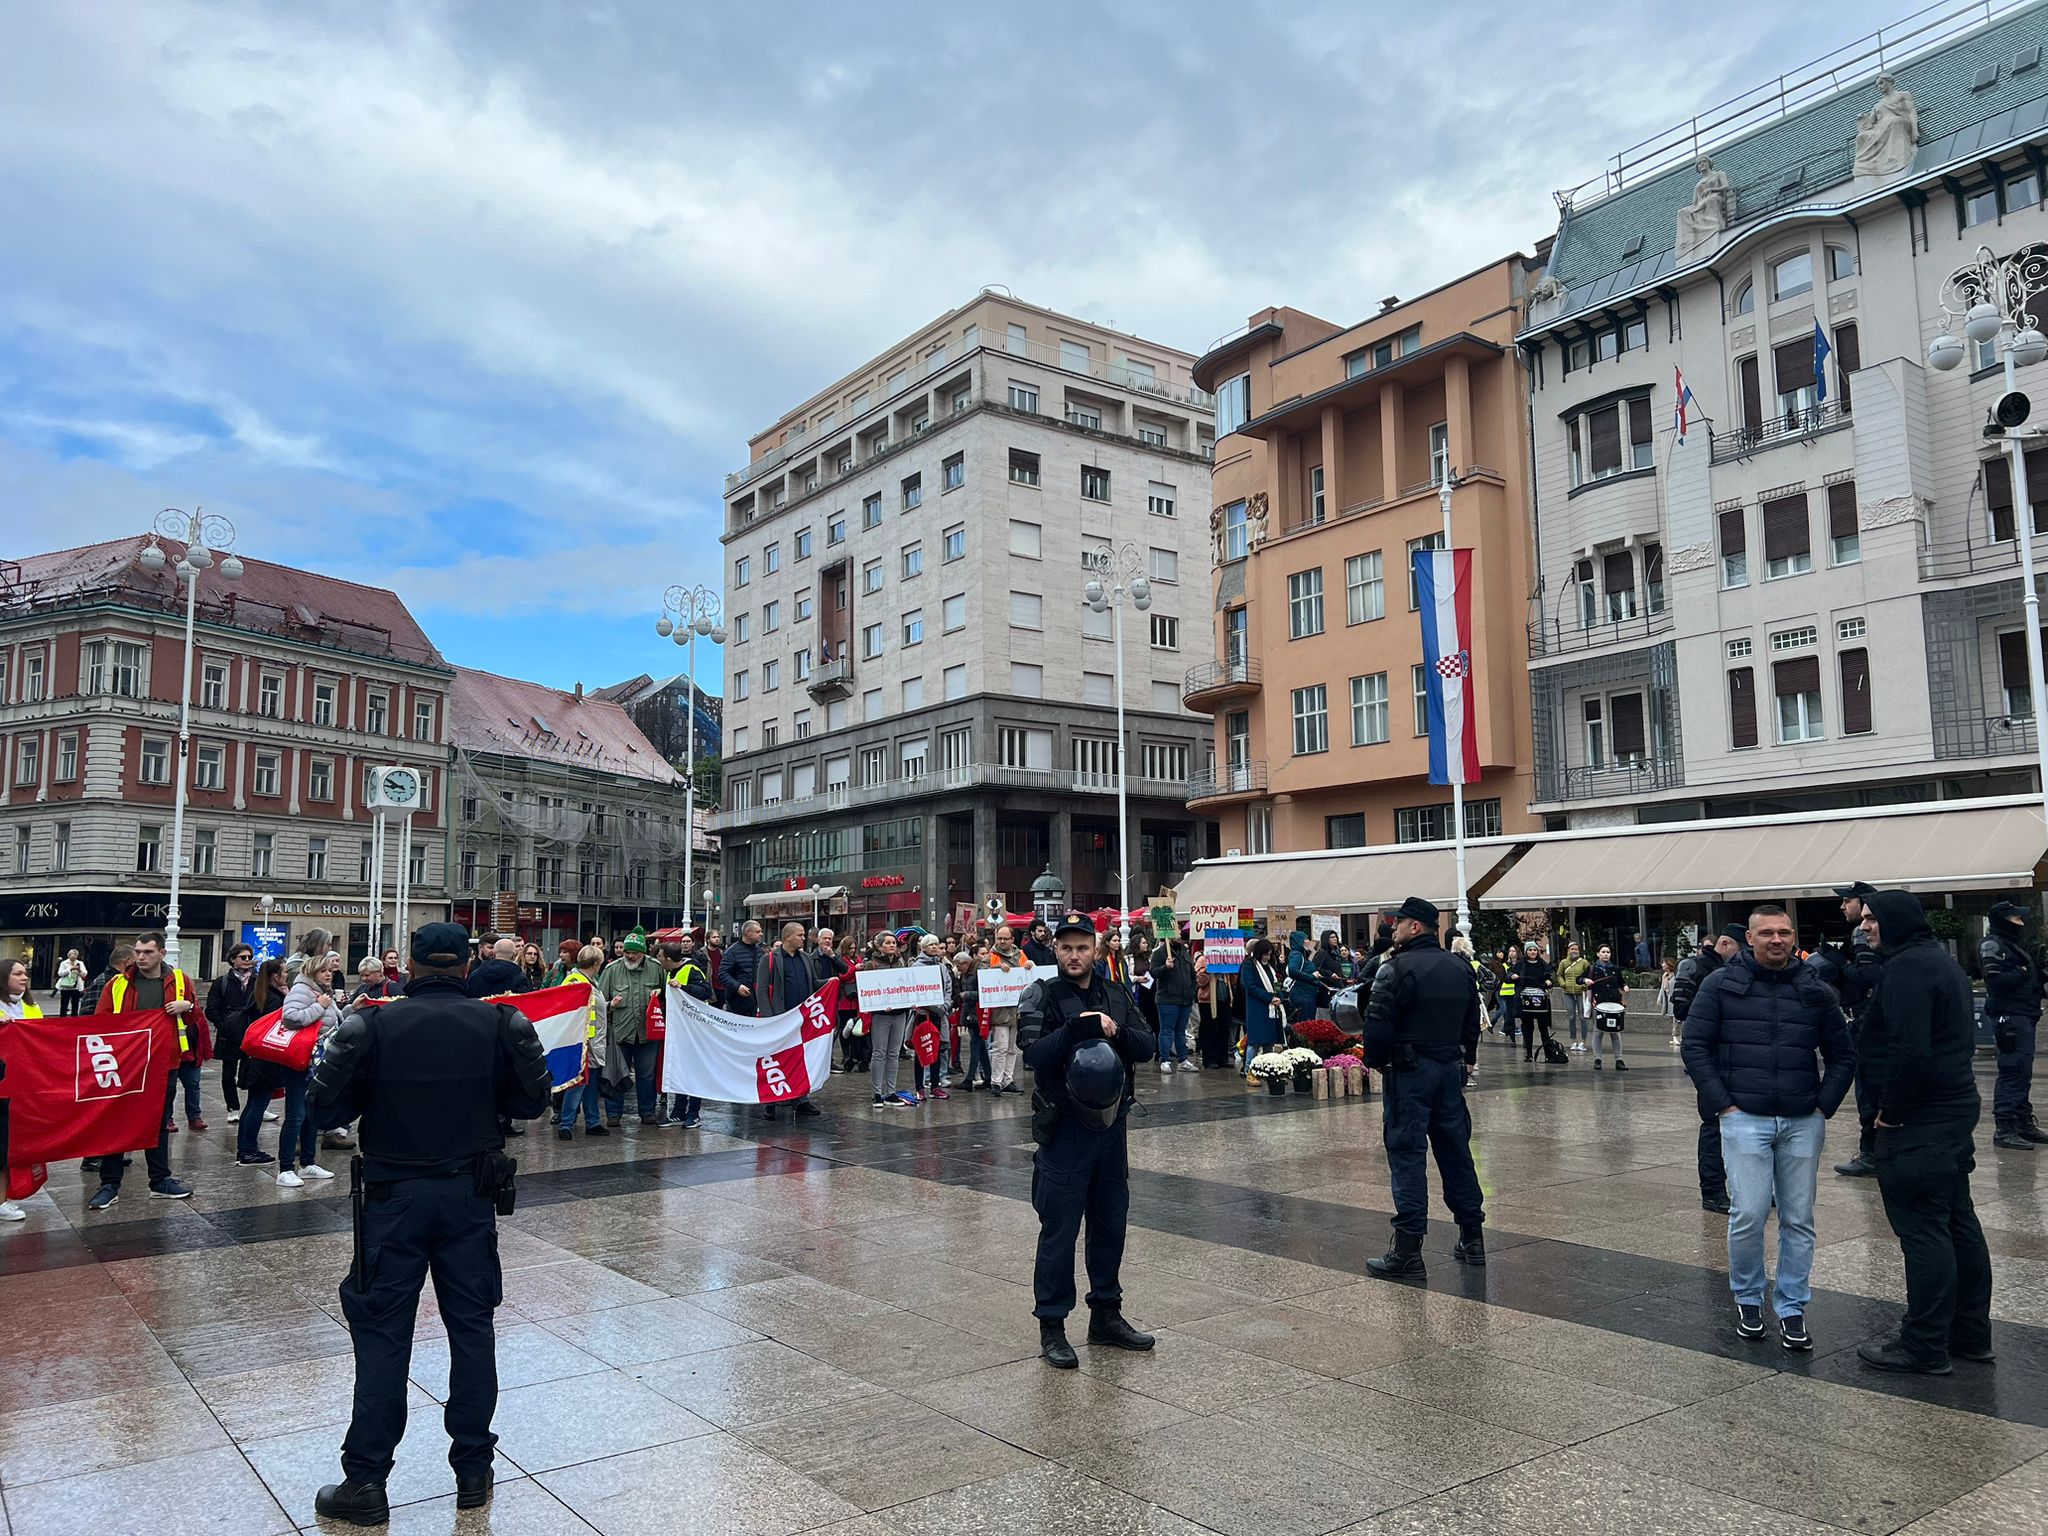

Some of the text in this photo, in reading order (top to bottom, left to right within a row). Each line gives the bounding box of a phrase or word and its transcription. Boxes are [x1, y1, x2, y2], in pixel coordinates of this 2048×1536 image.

[25, 902, 58, 918] ZAKS
[253, 901, 312, 914] AANIĆ
[1190, 905, 1236, 917] PATRIJARHAT
[860, 984, 940, 997] Zagreb #SafePlace4Women
[803, 995, 830, 1029] SDP
[86, 1035, 122, 1088] SDP
[761, 1055, 792, 1096] SDP
